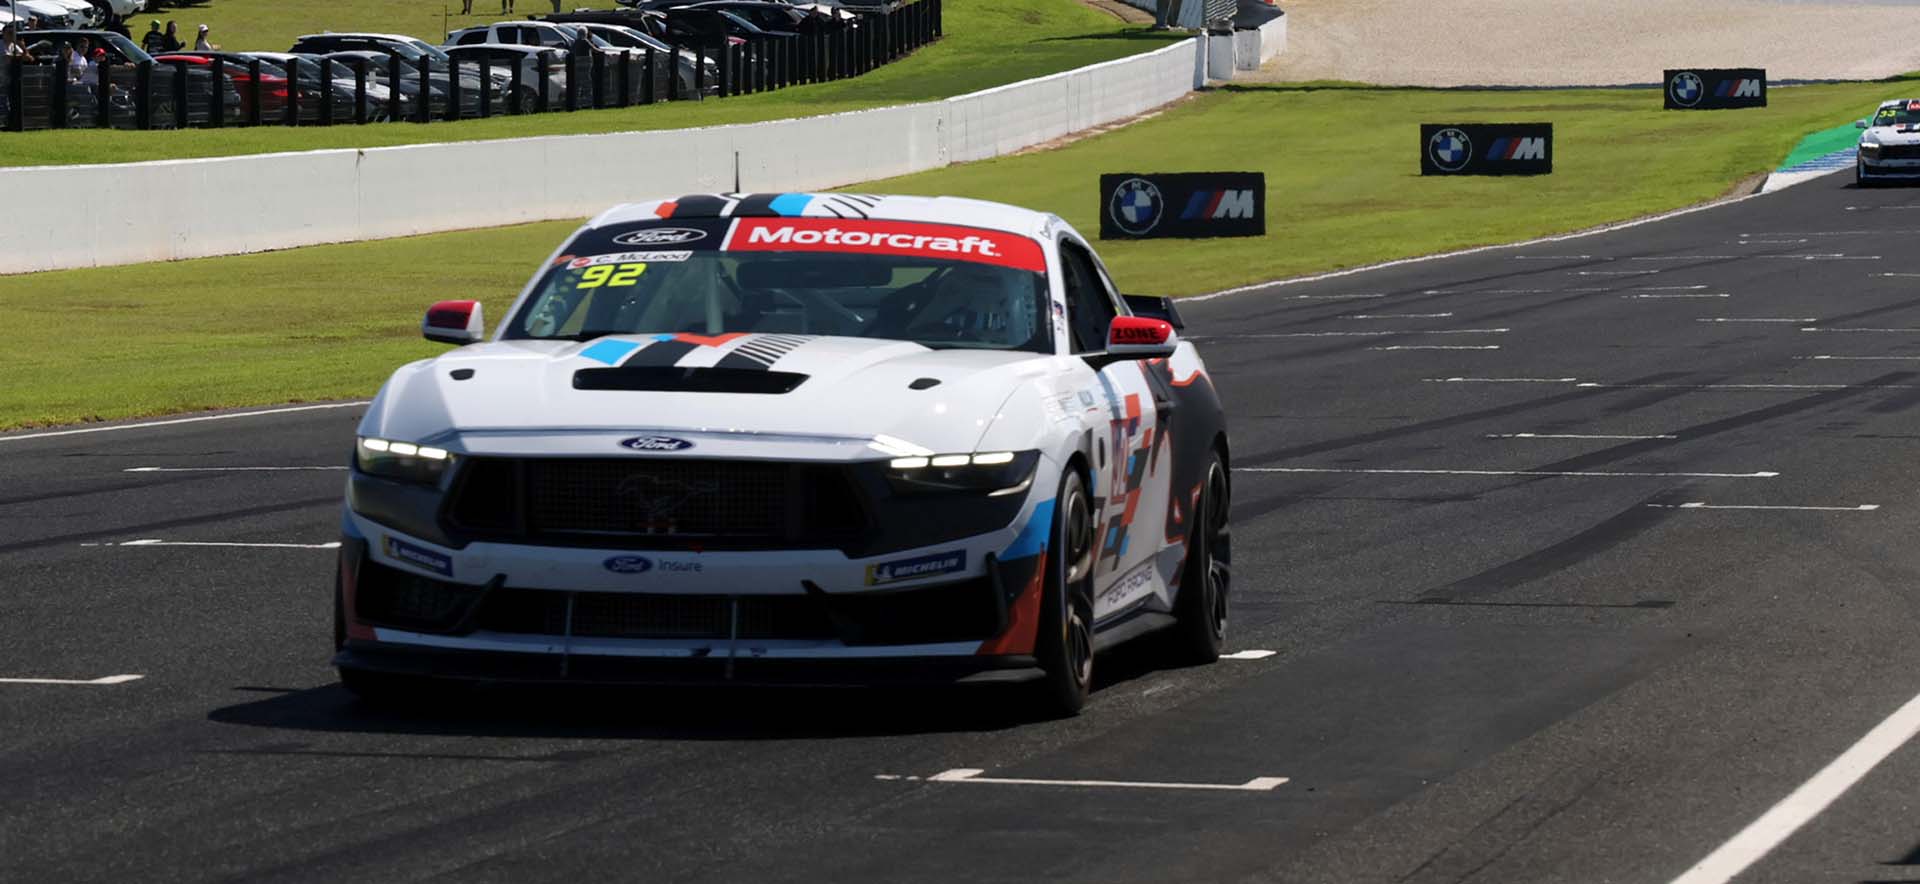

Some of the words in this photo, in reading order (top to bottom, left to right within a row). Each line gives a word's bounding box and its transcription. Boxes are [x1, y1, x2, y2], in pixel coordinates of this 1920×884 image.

[1880, 110, 1896, 118] 33
[1511, 137, 1545, 159] M
[1211, 189, 1254, 219] M
[627, 230, 691, 243] Ford
[617, 250, 689, 261] McLeod
[576, 263, 647, 289] 92
[1116, 327, 1158, 340] ZONE
[631, 436, 679, 450] Ford
[401, 546, 447, 569] MICHELIN
[611, 557, 645, 571] Ford
[658, 559, 703, 572] Insure
[894, 558, 959, 576] MICHELIN
